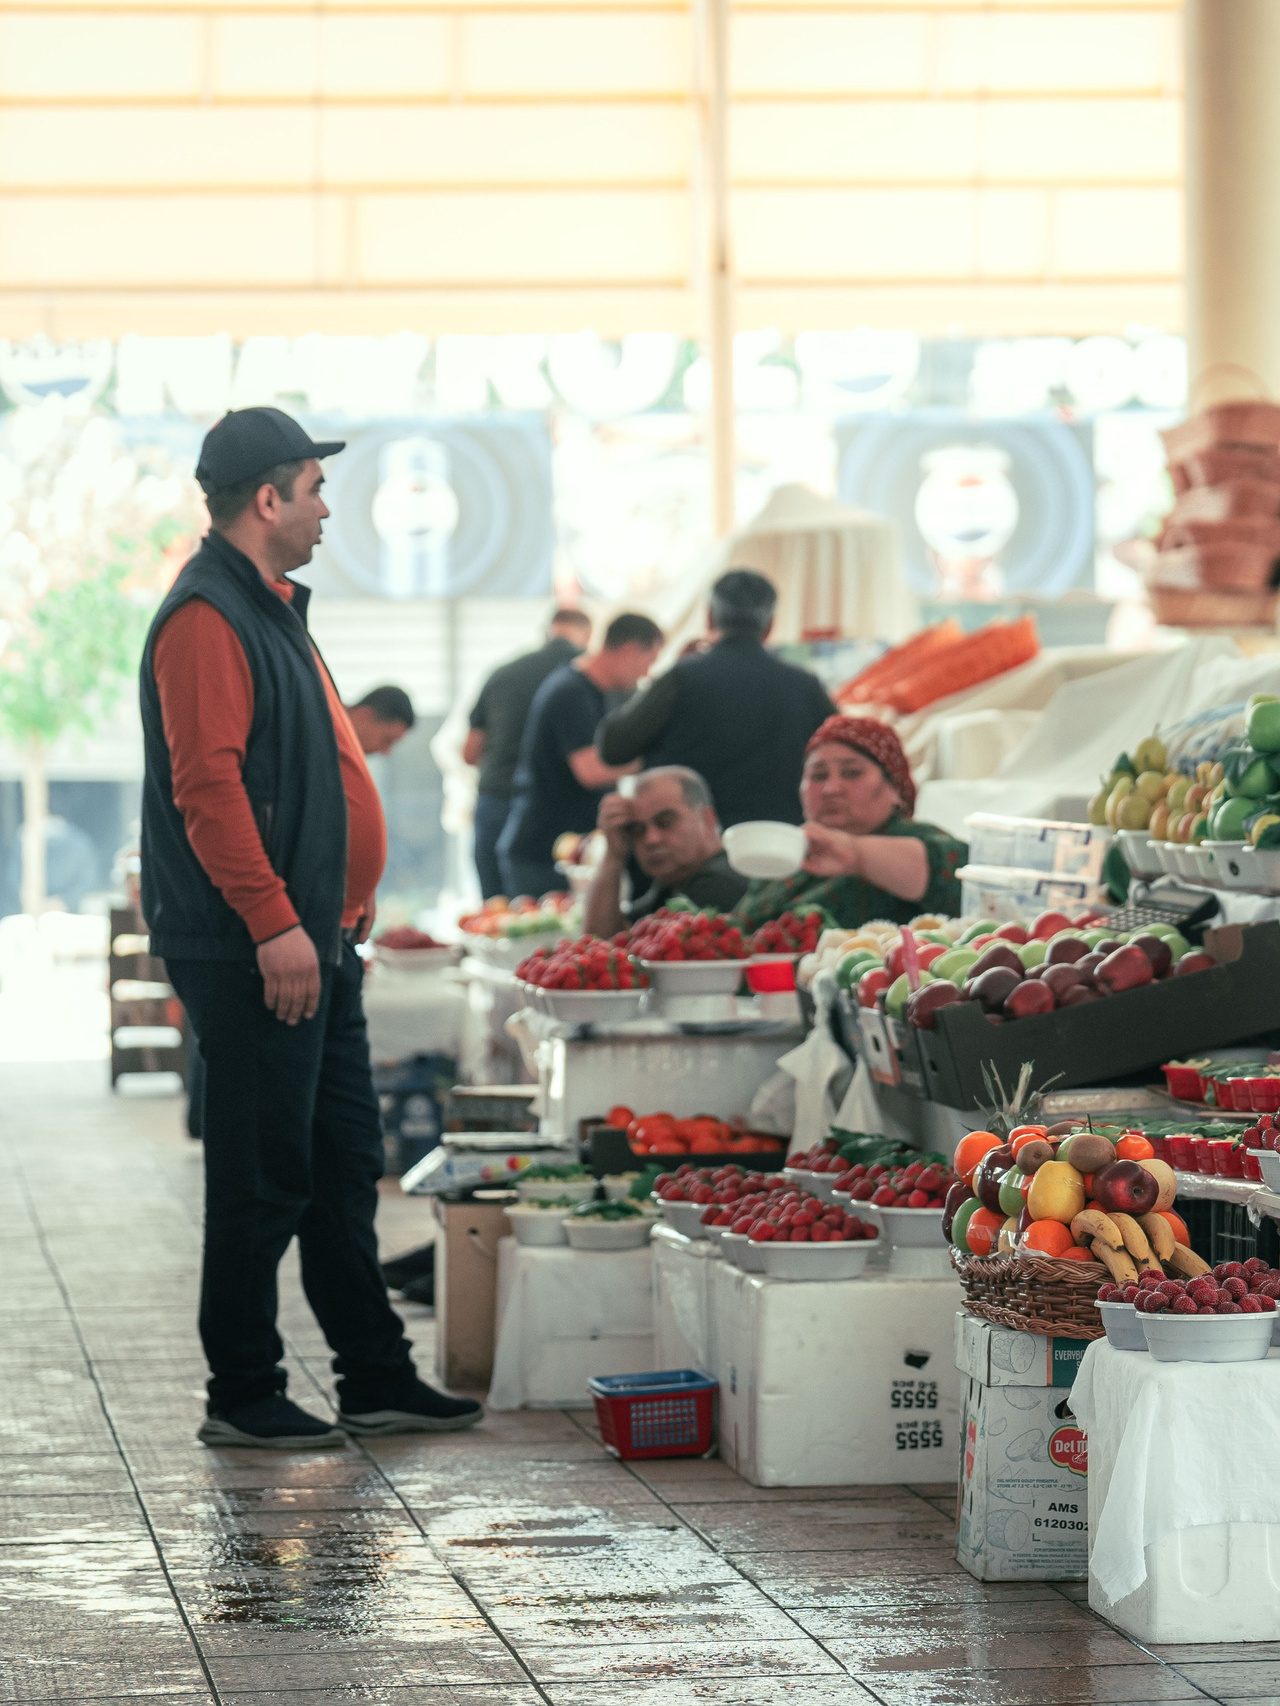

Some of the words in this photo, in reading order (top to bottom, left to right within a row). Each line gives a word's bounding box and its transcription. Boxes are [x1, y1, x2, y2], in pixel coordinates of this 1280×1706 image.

[890, 1390, 938, 1409] 5555
[895, 1429, 943, 1450] 5555
[1054, 1440, 1075, 1453] Del
[1048, 1502, 1079, 1513] AMS
